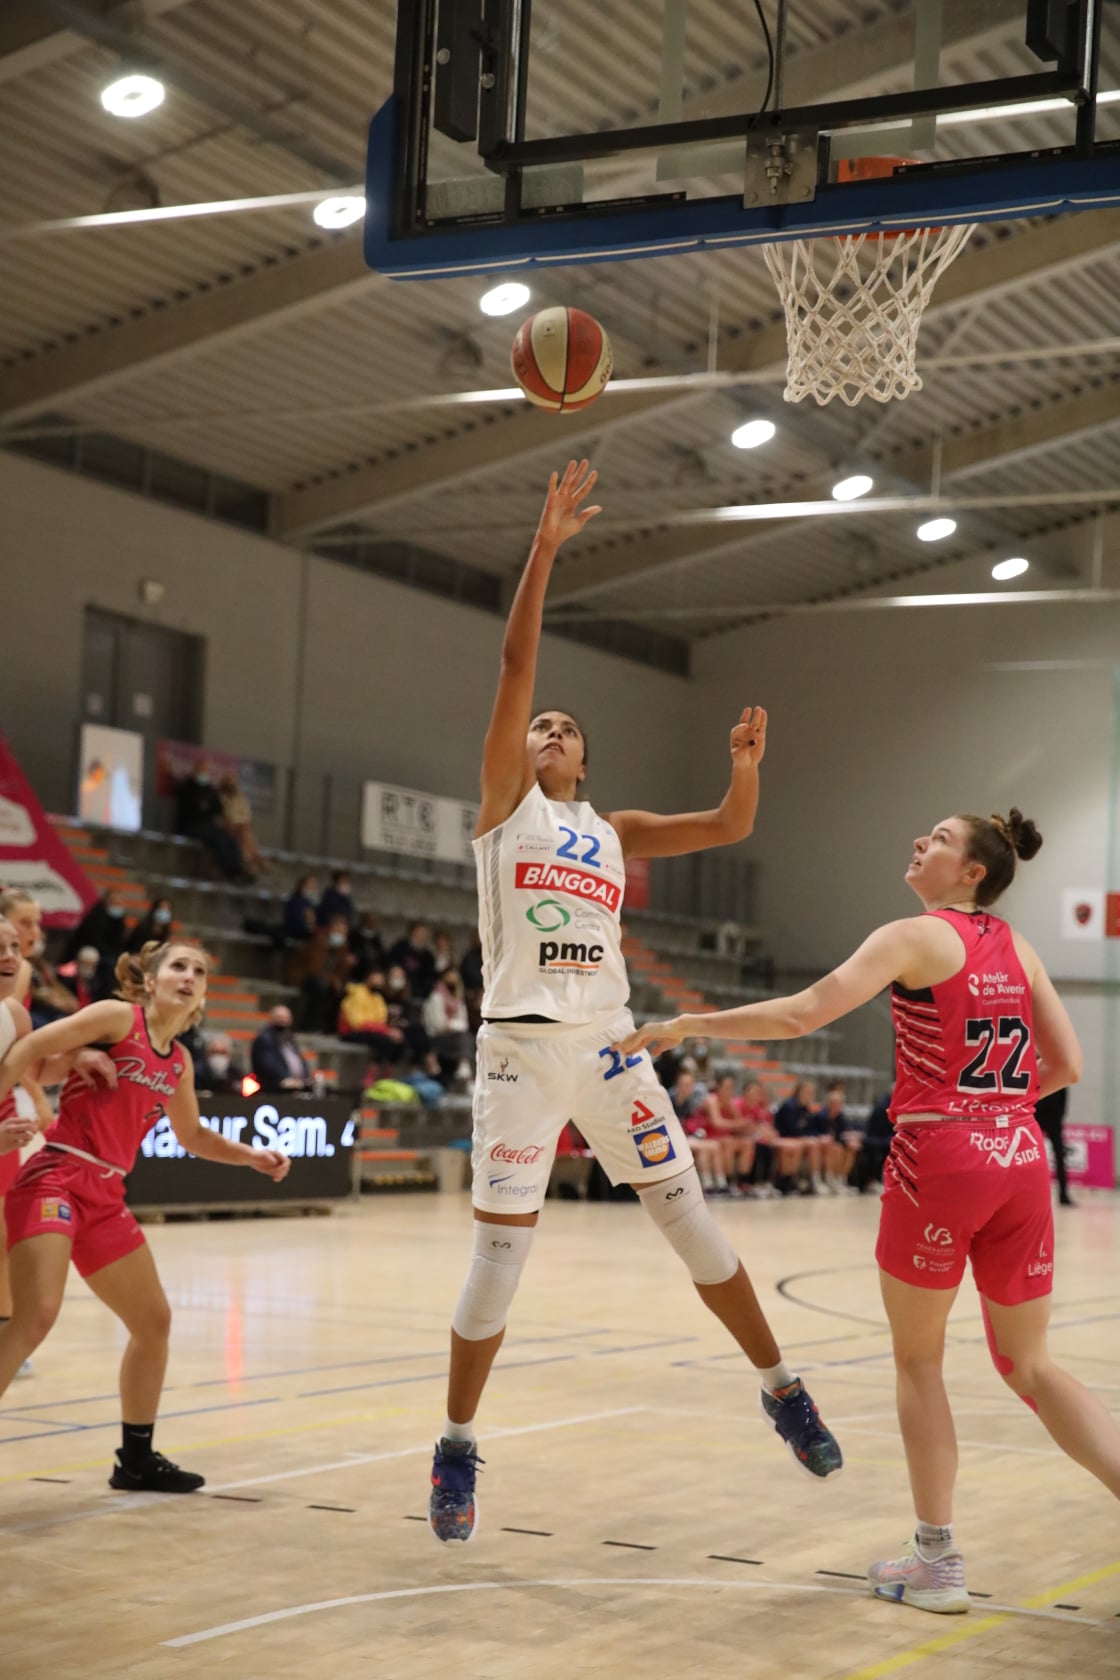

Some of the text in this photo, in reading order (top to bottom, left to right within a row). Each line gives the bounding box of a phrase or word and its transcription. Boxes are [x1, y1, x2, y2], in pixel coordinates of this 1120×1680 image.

[557, 826, 601, 868] 22
[538, 941, 604, 966] pmc
[982, 985, 995, 996] de
[957, 1015, 1031, 1095] 22
[487, 1072, 519, 1082] SKW
[252, 1105, 335, 1158] Sam.
[1014, 1146, 1041, 1165] SIDE
